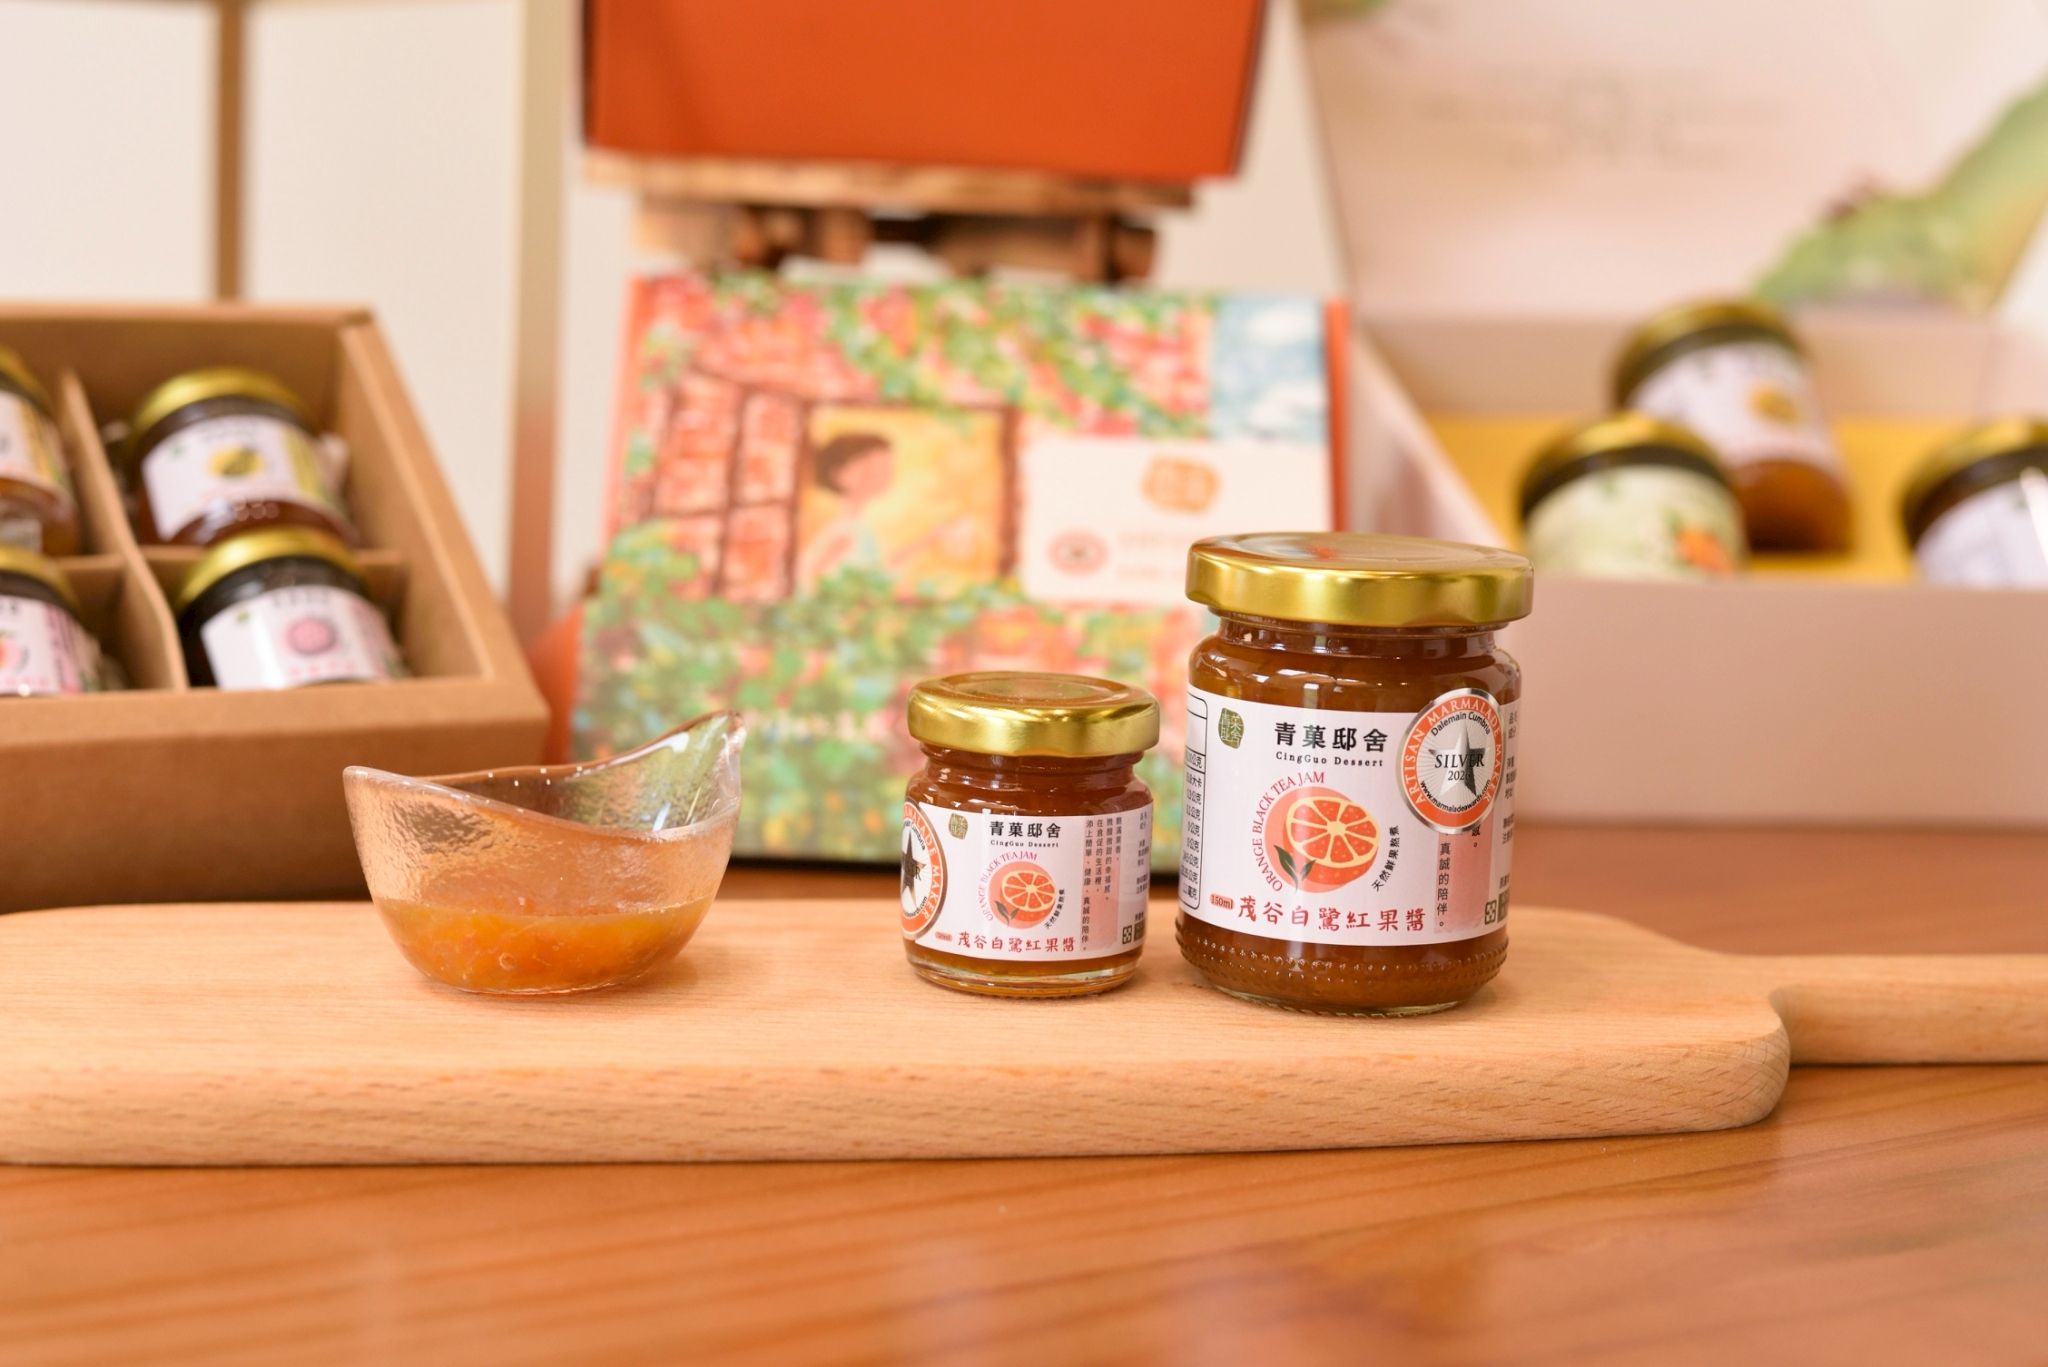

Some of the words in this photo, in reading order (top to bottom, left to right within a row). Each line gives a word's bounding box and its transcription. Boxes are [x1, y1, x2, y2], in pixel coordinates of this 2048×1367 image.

[1274, 721, 1388, 753] 青菓邸舍
[1430, 712, 1467, 737] Dalemain
[1468, 711, 1491, 736] Cumbria
[1275, 751, 1327, 765] CingGuo
[1334, 756, 1384, 767] Dessert
[1404, 728, 1425, 805] ARTISAN
[1427, 698, 1500, 737] MARMALADE
[1434, 753, 1485, 769] SILVER
[1270, 775, 1296, 796] TEA
[1297, 771, 1325, 787] JAM
[1252, 792, 1275, 834] BLACK
[989, 820, 1062, 839] 青菓邸舍
[990, 839, 1024, 848] CingGuo
[981, 858, 1002, 883] BLACK
[1000, 851, 1018, 862] TEA
[1019, 850, 1038, 861] JAM
[1252, 837, 1283, 892] ORANGE
[923, 865, 943, 920] MAKER
[1210, 893, 1234, 910] 150ml
[1237, 895, 1427, 932] 茂谷白鷺紅果醬
